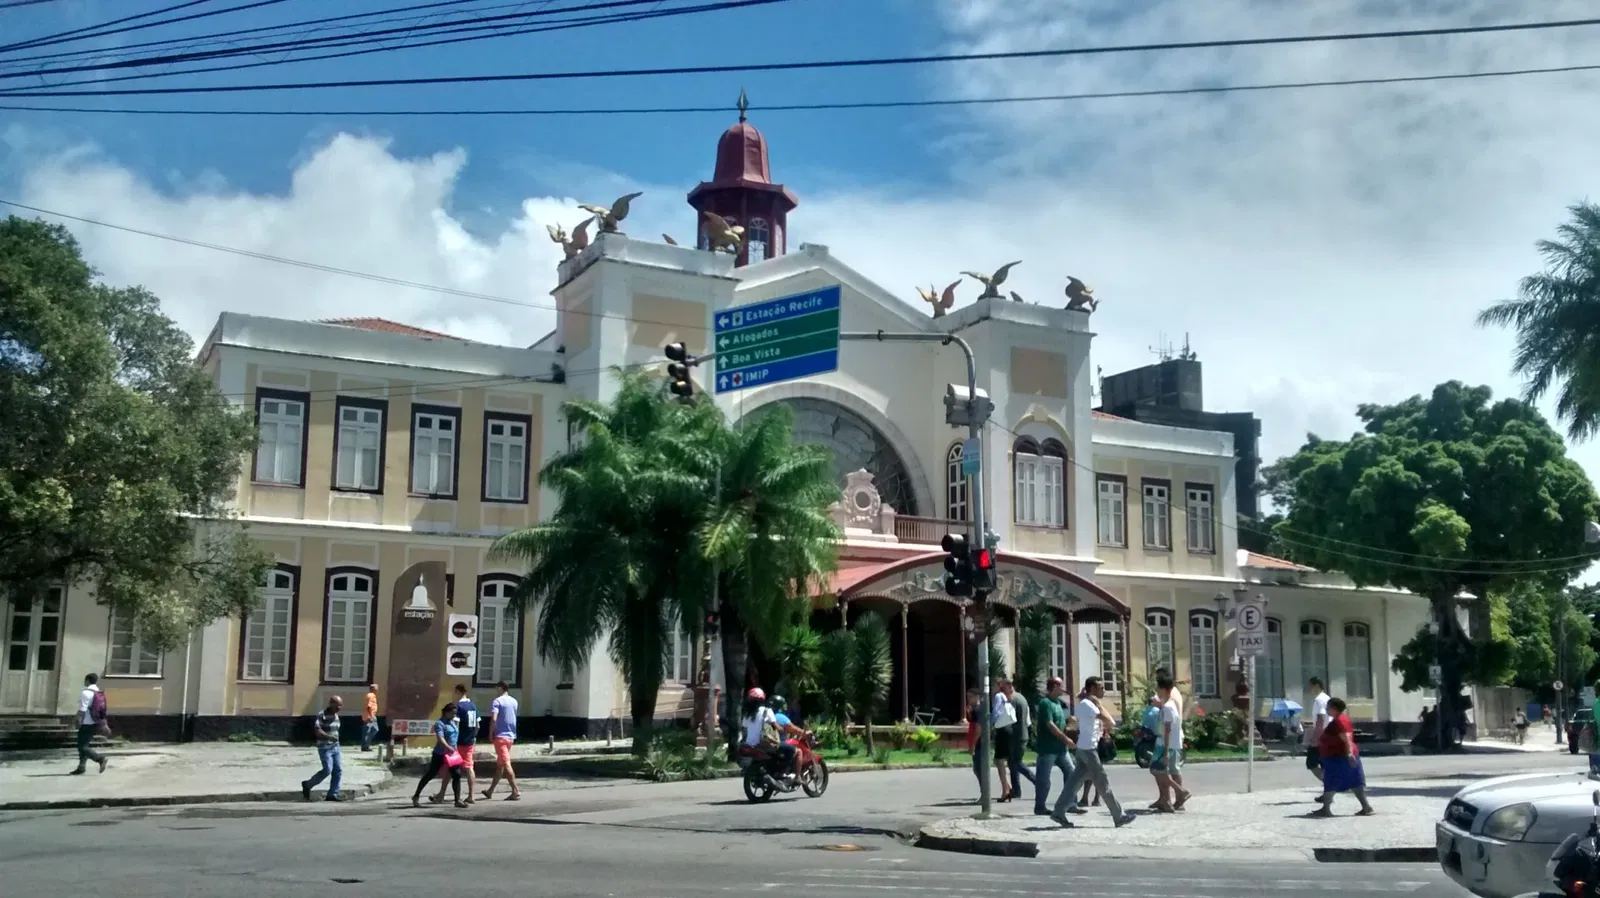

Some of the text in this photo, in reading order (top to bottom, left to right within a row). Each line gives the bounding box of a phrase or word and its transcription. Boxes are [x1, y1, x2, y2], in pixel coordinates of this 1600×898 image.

[746, 297, 823, 321] Estação Recife
[733, 327, 779, 345] Afogados
[732, 347, 781, 364] Boa Vista
[745, 369, 769, 382] IMIP
[404, 610, 434, 620] estação
[1246, 610, 1254, 625] E
[1239, 637, 1263, 646] TAXI
